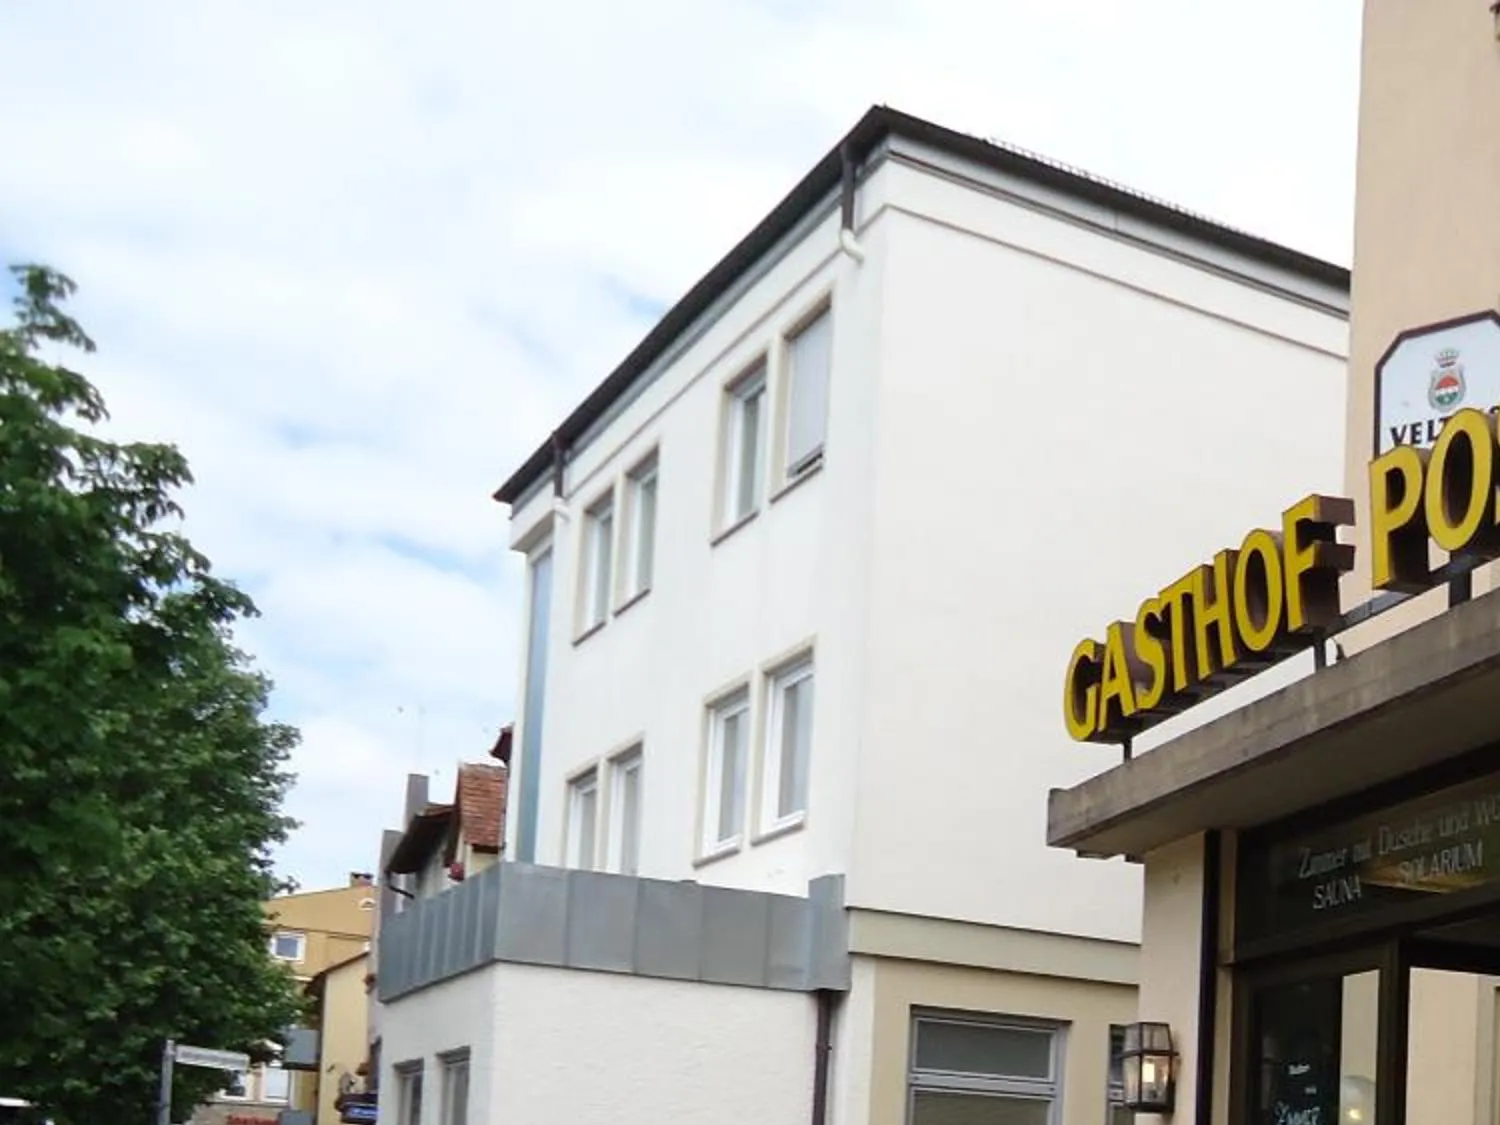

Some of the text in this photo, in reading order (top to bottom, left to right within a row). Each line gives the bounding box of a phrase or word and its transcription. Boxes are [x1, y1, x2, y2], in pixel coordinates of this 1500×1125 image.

[1064, 494, 1321, 742] GASTHOF
[1438, 807, 1470, 836] und
[1313, 838, 1485, 910] SAUNA SOLARIUM
